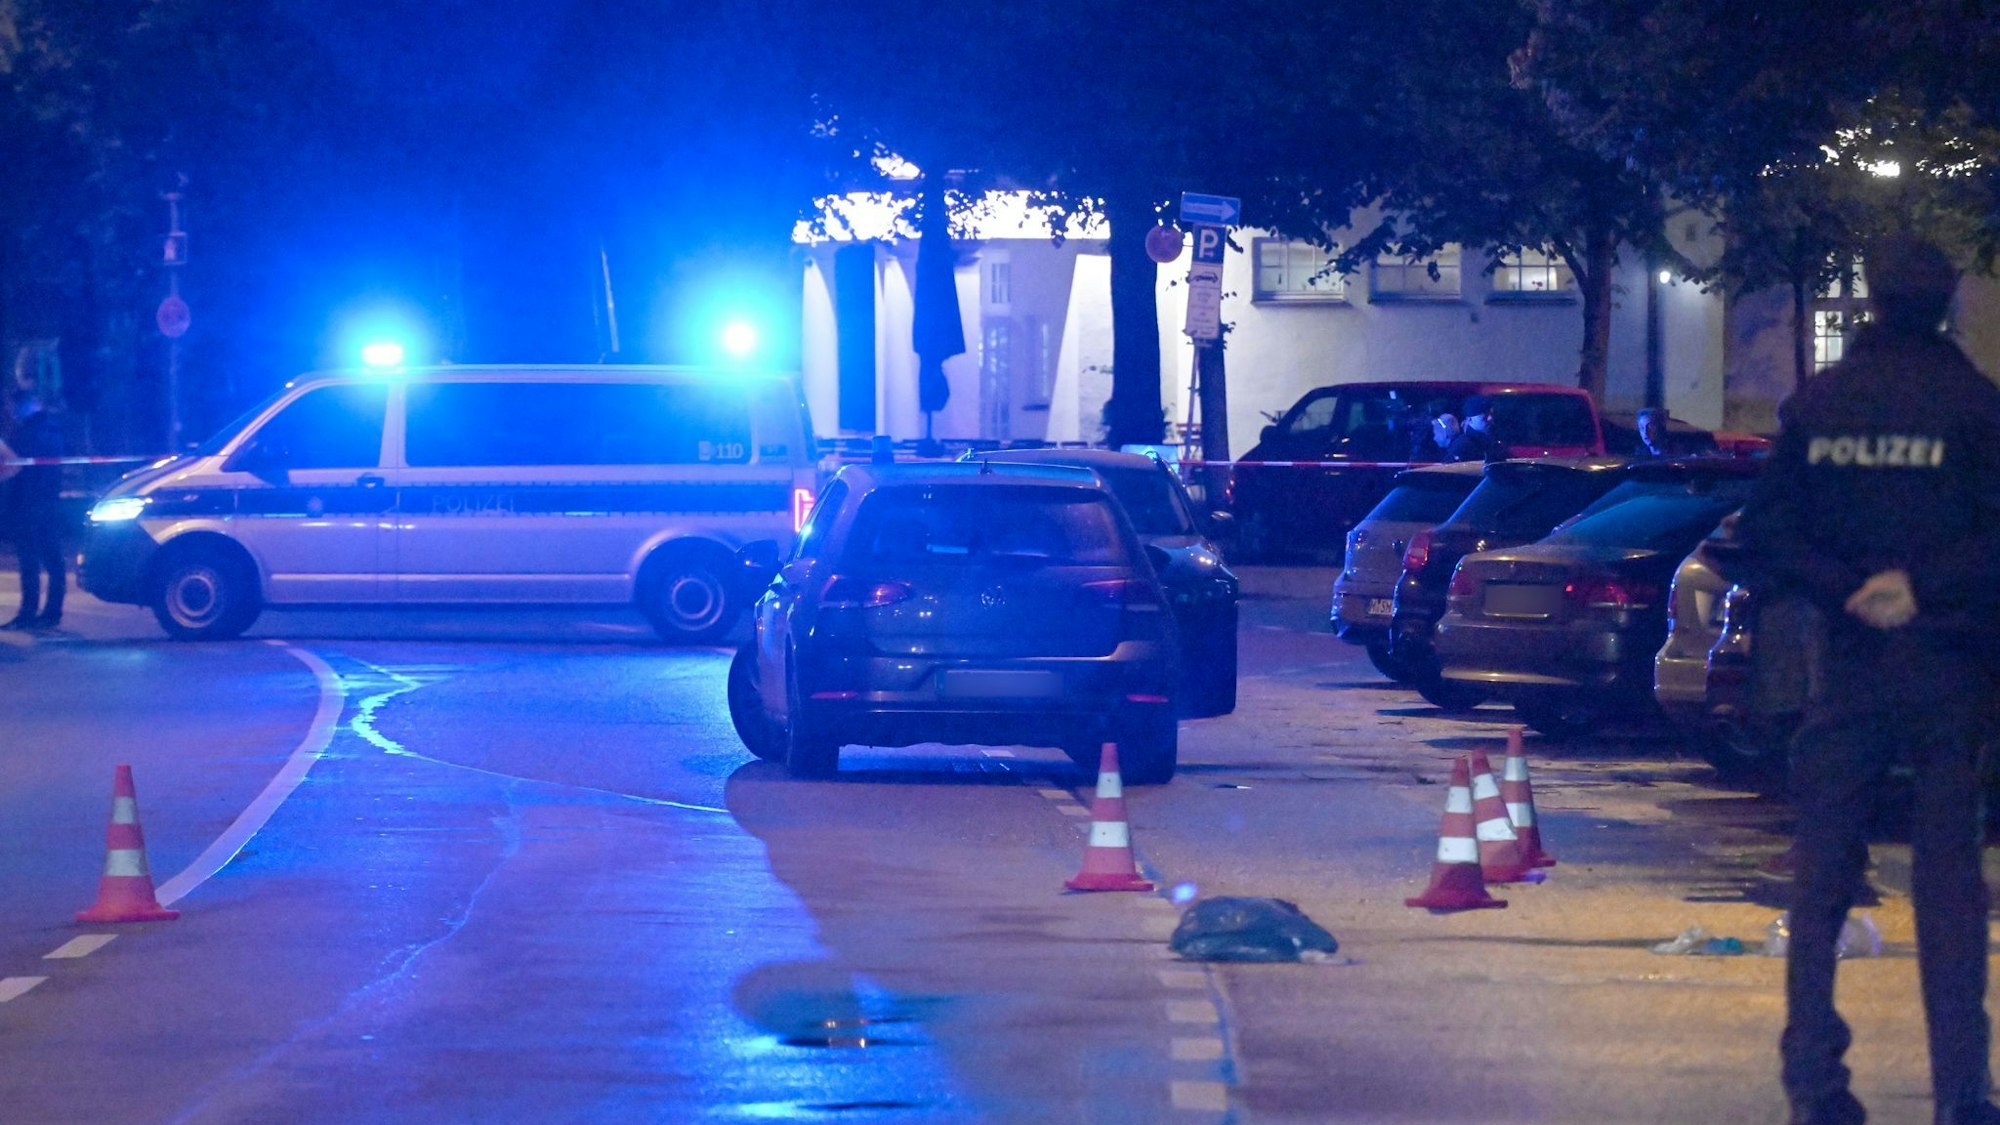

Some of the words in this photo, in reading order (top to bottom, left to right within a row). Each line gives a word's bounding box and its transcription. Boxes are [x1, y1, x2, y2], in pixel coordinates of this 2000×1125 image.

[1200, 229, 1219, 258] P
[716, 442, 744, 459] 110
[1808, 436, 1945, 466] POLIZEI
[432, 494, 514, 513] POLIZEI
